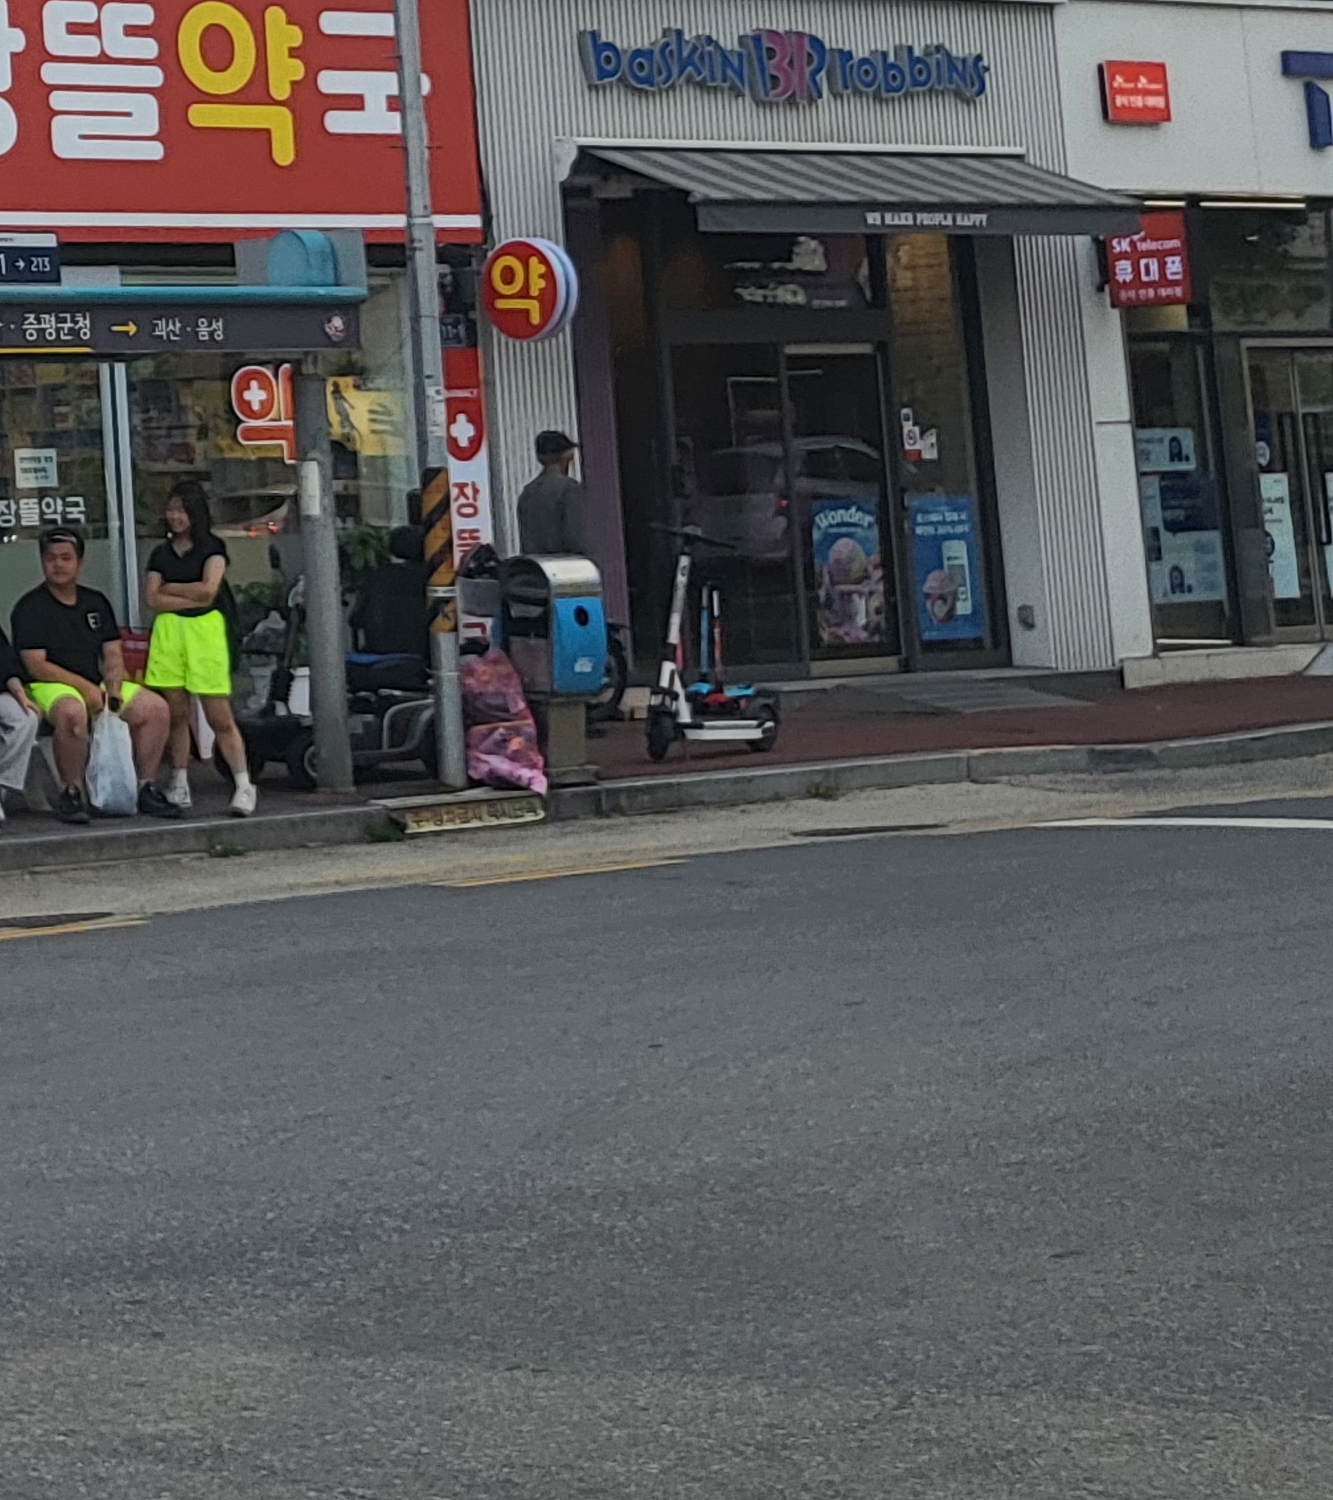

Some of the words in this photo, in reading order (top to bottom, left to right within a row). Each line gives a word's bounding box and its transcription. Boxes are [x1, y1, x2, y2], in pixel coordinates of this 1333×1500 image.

[30, 256, 51, 273] 213
[490, 254, 547, 325] 약
[21, 312, 93, 341] 증평군청
[151, 317, 183, 341] 괴산
[194, 317, 226, 341] 음성
